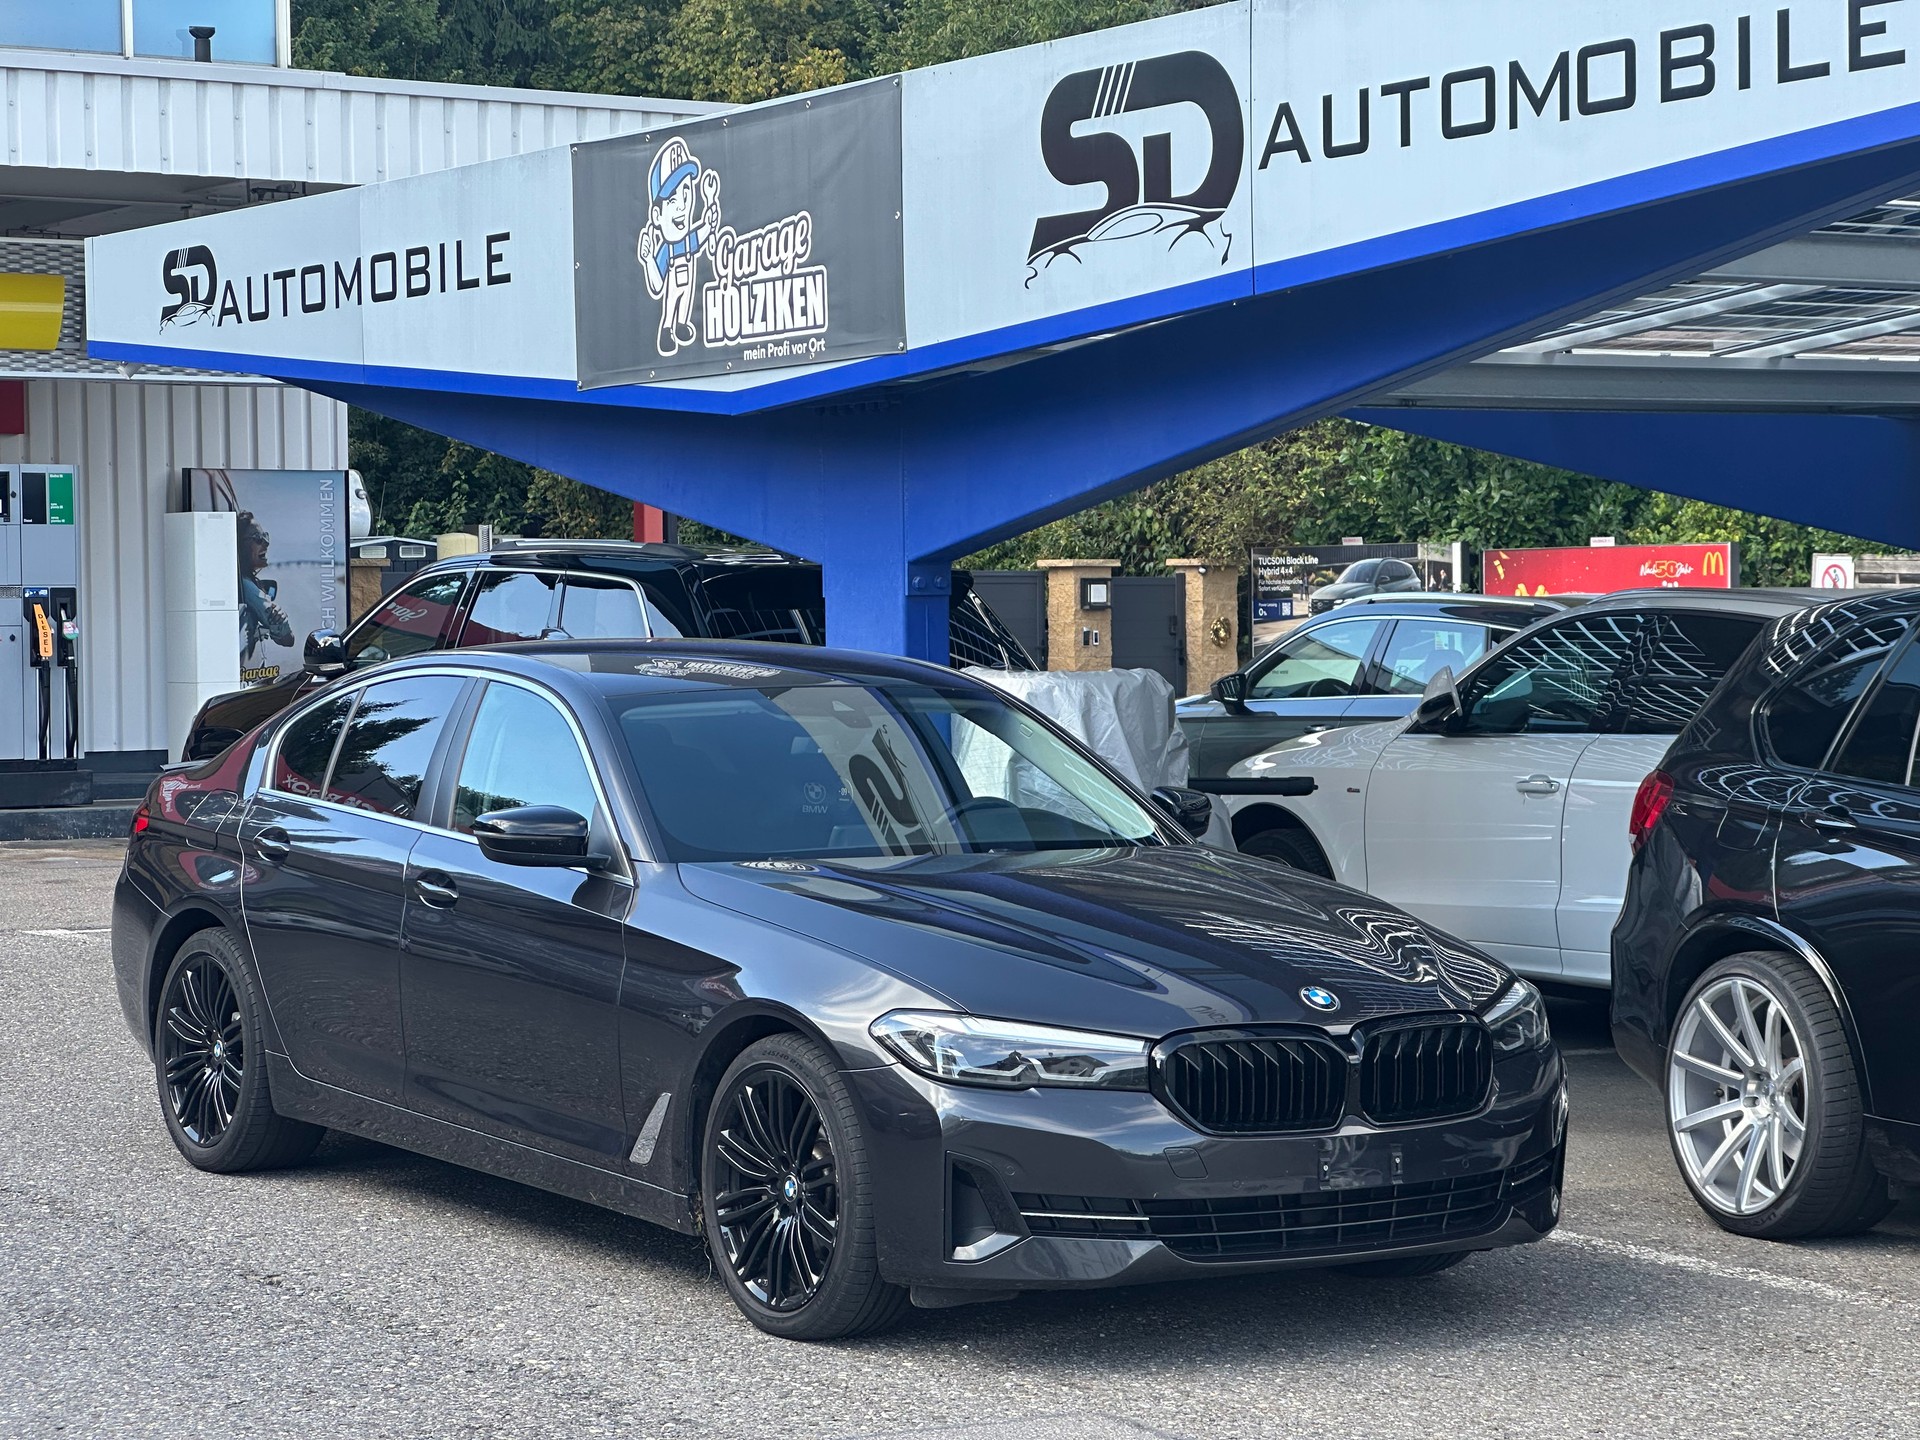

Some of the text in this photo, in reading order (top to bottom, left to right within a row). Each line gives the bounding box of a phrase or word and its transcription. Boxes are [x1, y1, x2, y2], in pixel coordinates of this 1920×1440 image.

[1026, 0, 1906, 268] SD AUTOMOBILE
[716, 218, 808, 292] Garage
[161, 231, 512, 327] SD AUTOMOBILE
[706, 273, 824, 340] HOLZIKEN
[743, 337, 826, 361] mein Profi vor Ort
[319, 479, 335, 602] WILLKOMMEN
[1258, 557, 1286, 566] TUCSON
[1304, 555, 1319, 565] Line
[1258, 566, 1293, 577] Hybrid 4x4
[1655, 560, 1678, 578] 50
[37, 613, 49, 653] DIESEL
[802, 804, 829, 815] BMW
